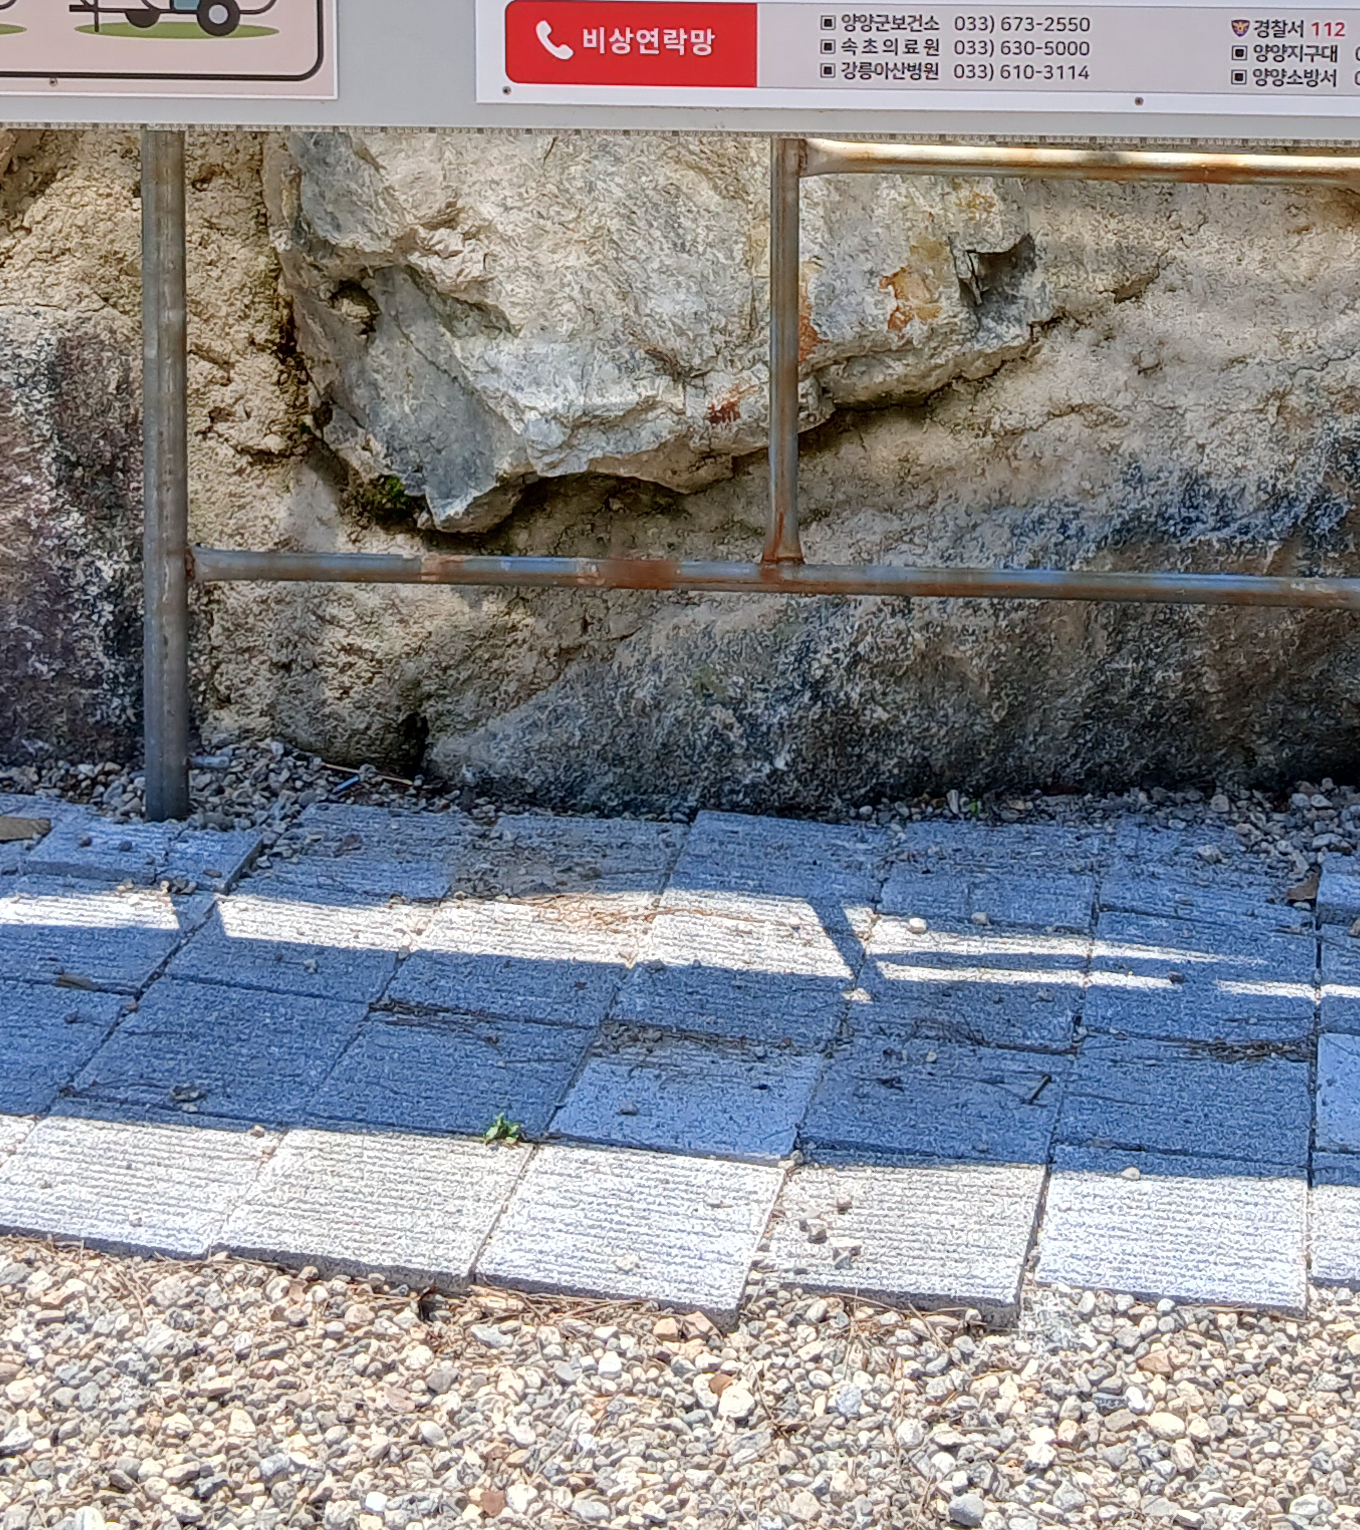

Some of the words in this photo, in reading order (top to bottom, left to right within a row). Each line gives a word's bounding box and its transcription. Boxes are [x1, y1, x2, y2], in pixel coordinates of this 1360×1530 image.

[841, 14, 940, 33] 양양군보건소
[954, 16, 995, 34] 033)
[1001, 16, 1091, 32] 673-2550
[1254, 19, 1304, 39] 경찰서
[1312, 22, 1345, 37] 112
[583, 28, 715, 55] 비상연락망
[954, 40, 995, 58] 033)
[1000, 40, 1090, 56] 630-5000
[1253, 44, 1338, 63] 양양지구대
[841, 62, 939, 81] 강릉아산병원
[954, 64, 994, 81] 033)
[1000, 64, 1089, 80] 610-3114
[1252, 68, 1337, 88] 양양소방서
